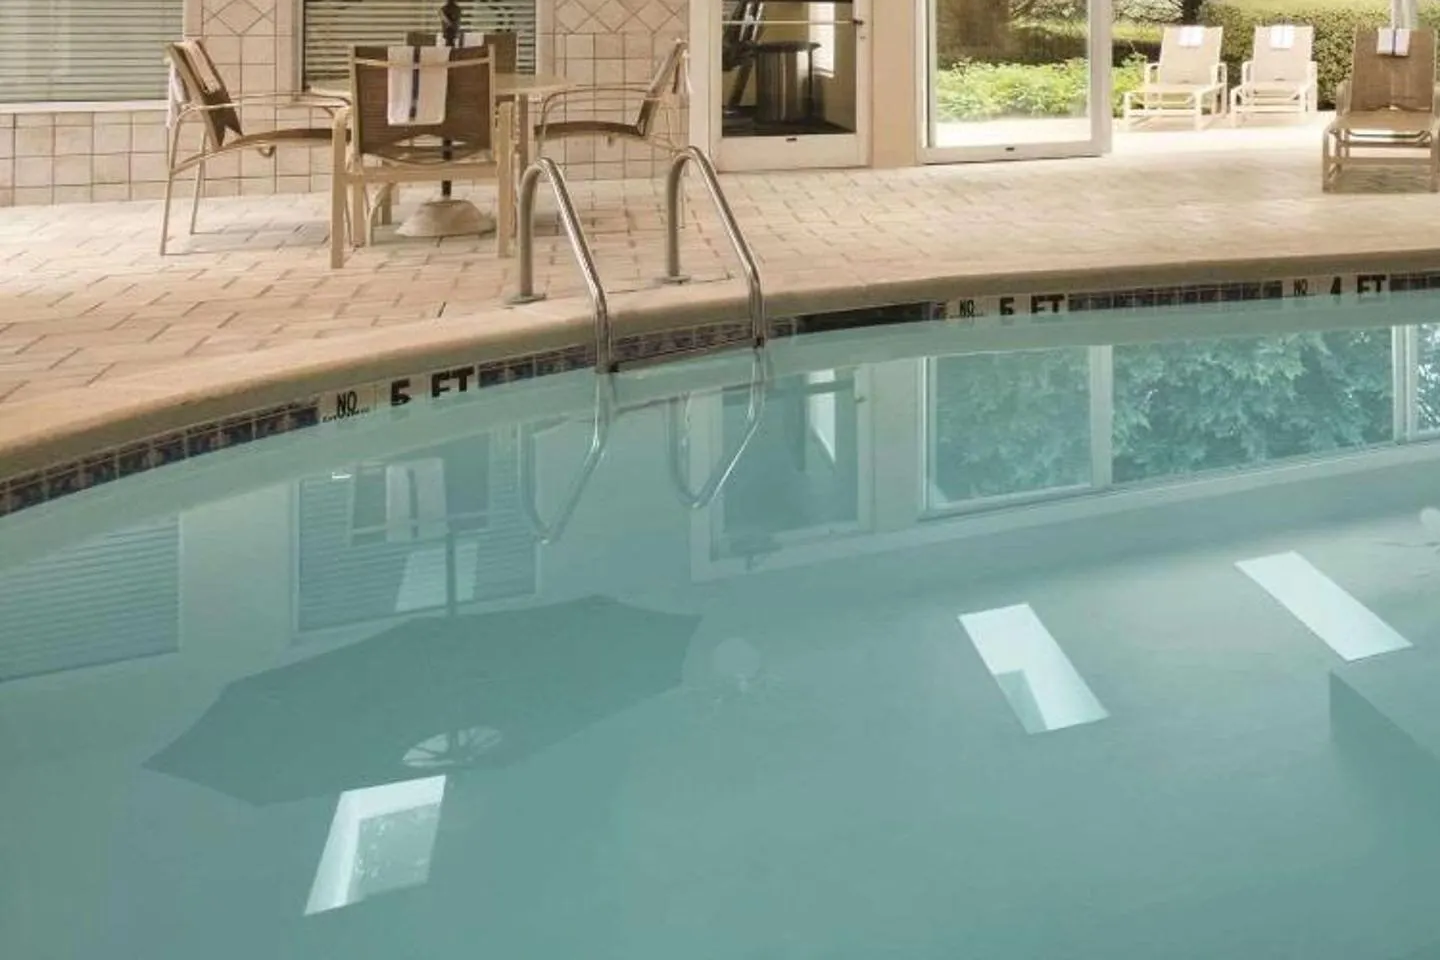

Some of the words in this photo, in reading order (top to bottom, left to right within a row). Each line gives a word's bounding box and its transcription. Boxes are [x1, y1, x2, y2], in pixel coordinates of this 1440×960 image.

[1357, 274, 1387, 294] FT
[1031, 294, 1065, 314] FT
[336, 390, 358, 419] NO
[391, 378, 412, 406] 5
[431, 366, 474, 398] FT
